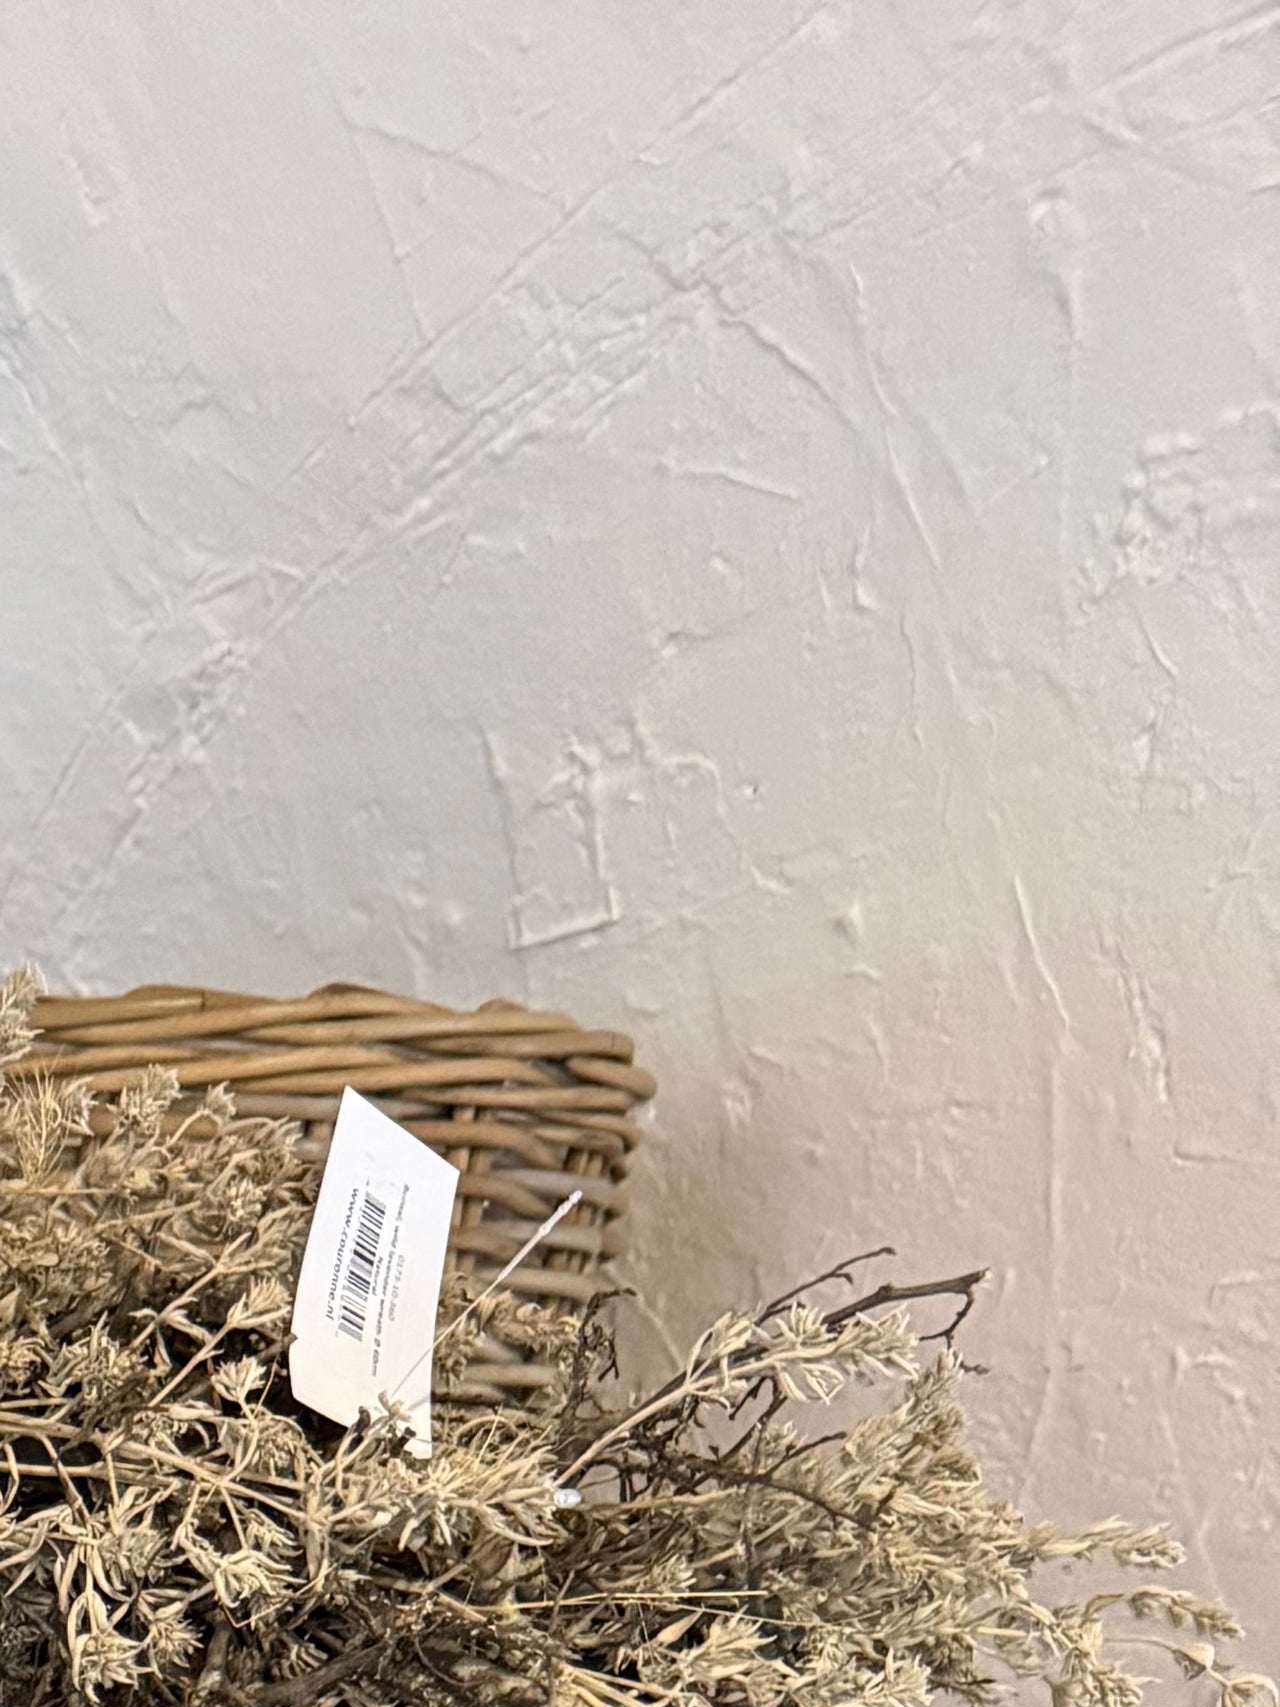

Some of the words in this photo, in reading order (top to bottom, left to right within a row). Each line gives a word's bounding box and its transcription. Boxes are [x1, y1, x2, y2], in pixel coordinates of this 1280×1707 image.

[325, 1188, 359, 1321] www.couronne.nl
[372, 1256, 383, 1297] Natural
[382, 1250, 395, 1297] lavender
